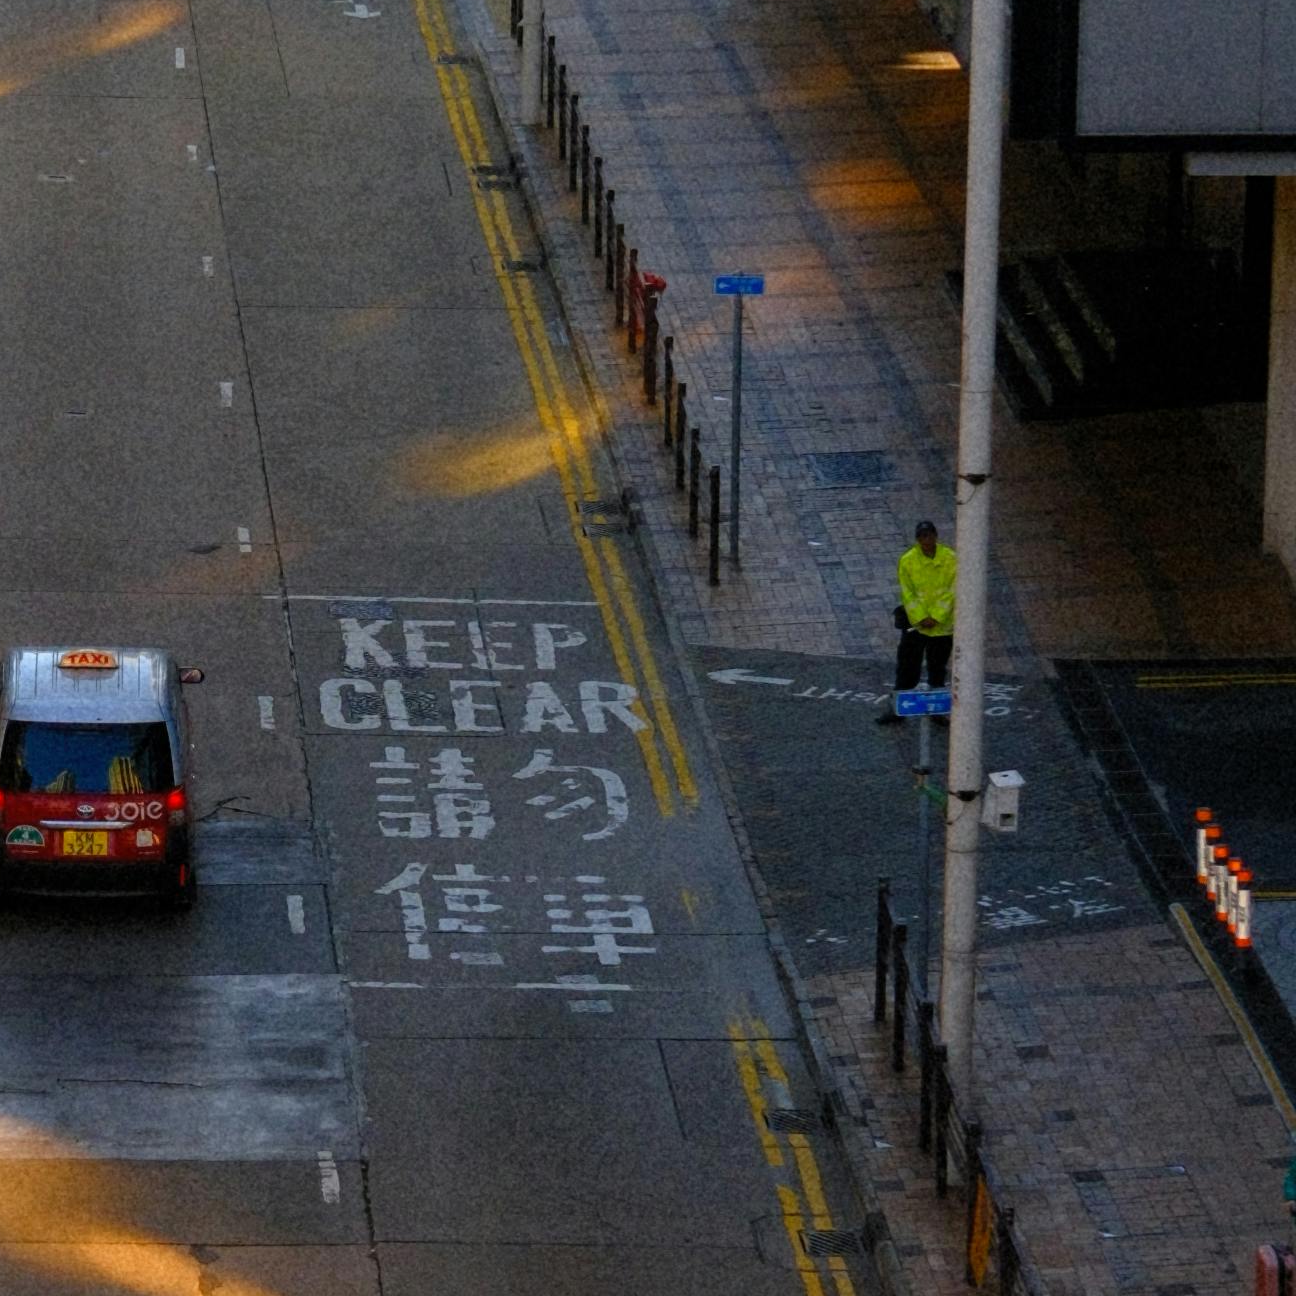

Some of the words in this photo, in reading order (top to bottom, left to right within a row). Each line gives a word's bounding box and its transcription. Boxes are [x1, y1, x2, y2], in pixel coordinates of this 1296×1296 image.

[67, 653, 109, 664] TAXI
[340, 618, 588, 670] KEEP
[319, 678, 648, 733] CLEAR
[369, 747, 629, 840] 請勿
[68, 844, 104, 855] 3247
